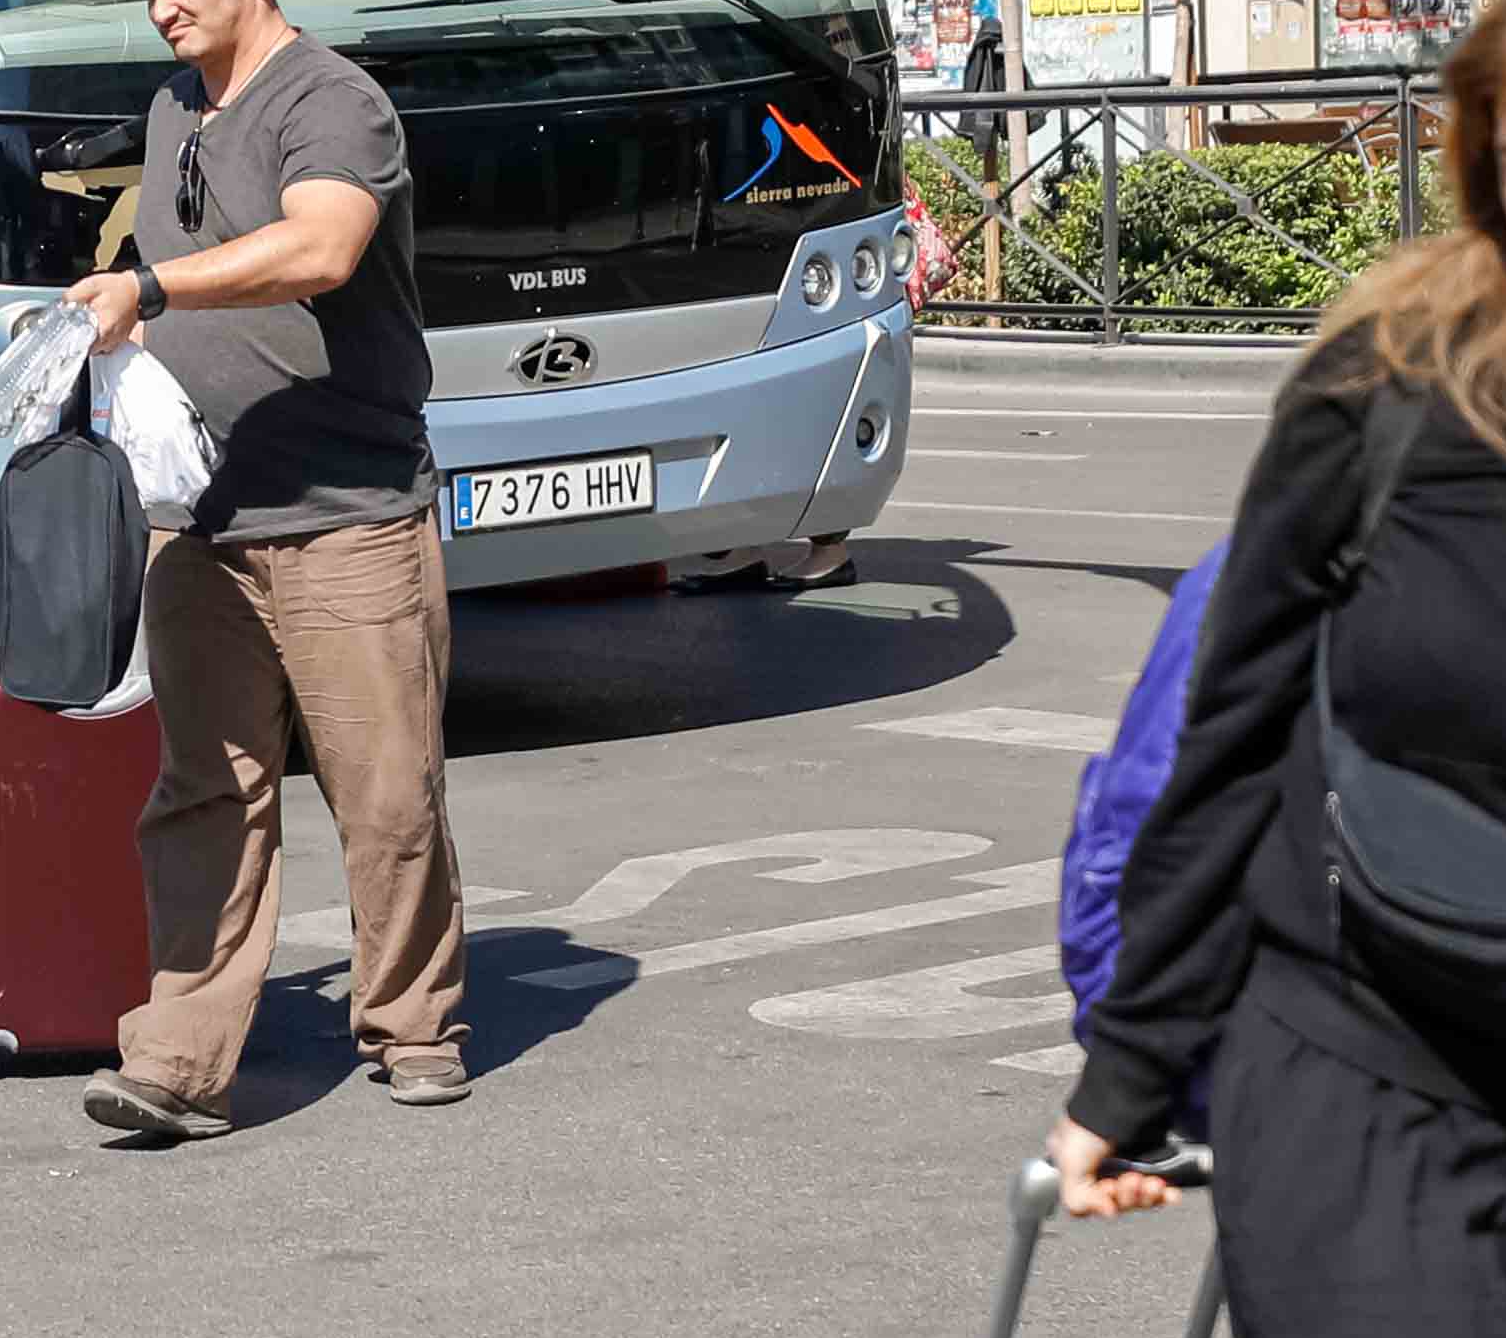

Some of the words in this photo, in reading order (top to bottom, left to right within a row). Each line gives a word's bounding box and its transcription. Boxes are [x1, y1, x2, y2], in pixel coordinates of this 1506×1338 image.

[745, 185, 793, 204] sierra
[796, 176, 850, 198] nevada
[508, 271, 548, 291] VDL
[551, 267, 587, 287] BUS
[474, 473, 570, 520] 7376
[586, 461, 641, 507] HHV
[460, 507, 469, 519] E
